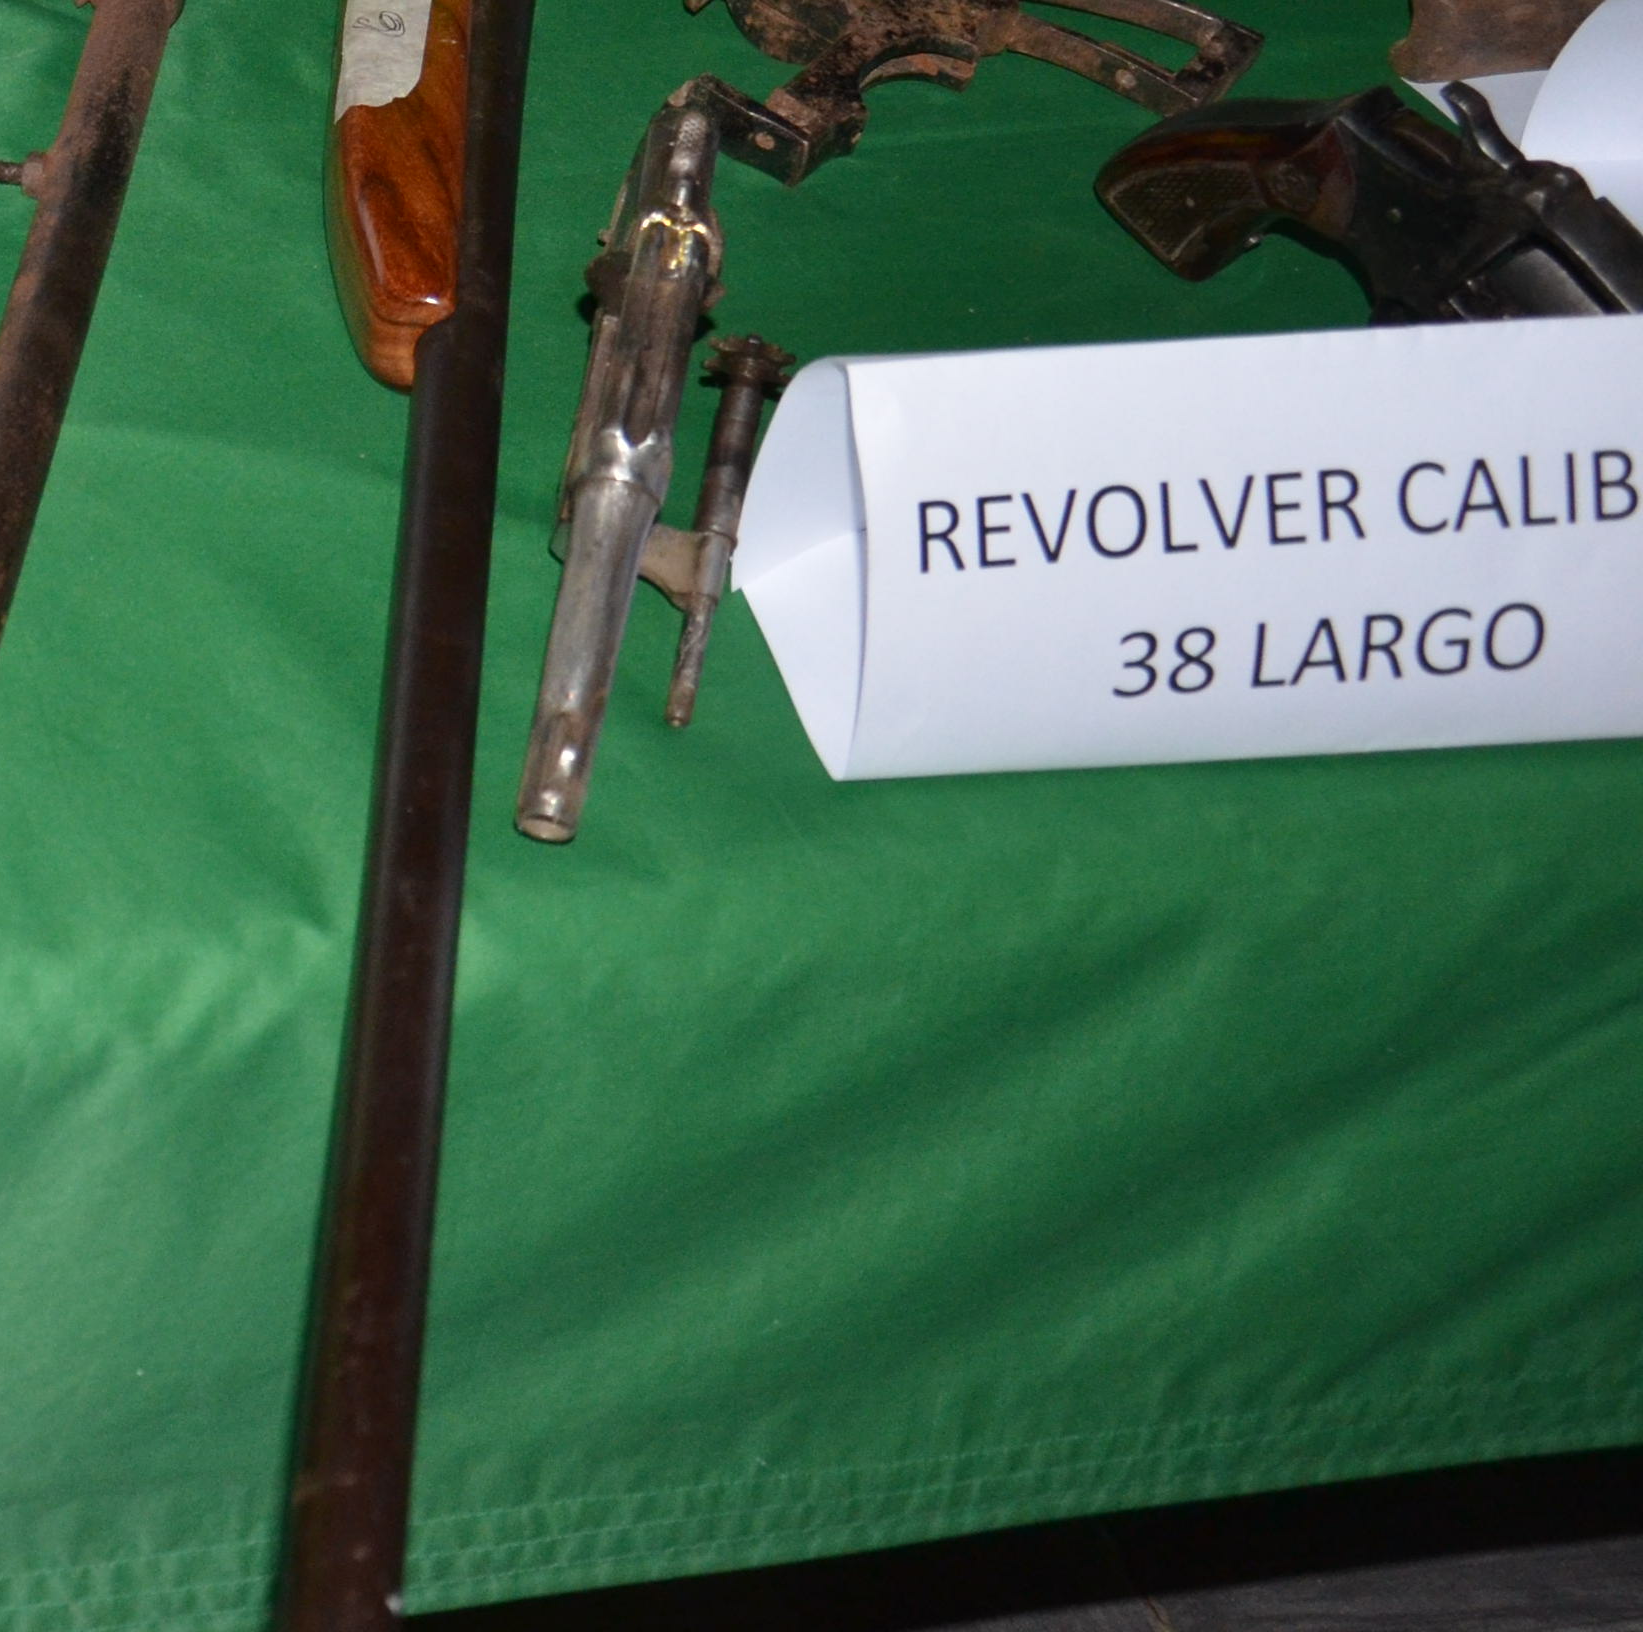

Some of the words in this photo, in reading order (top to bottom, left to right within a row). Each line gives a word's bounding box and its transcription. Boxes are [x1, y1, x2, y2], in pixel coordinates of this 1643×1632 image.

[917, 466, 1367, 574] REVOLVER
[1397, 448, 1642, 534] CALIB
[1111, 626, 1216, 697] 38
[1250, 602, 1546, 690] LARGO
